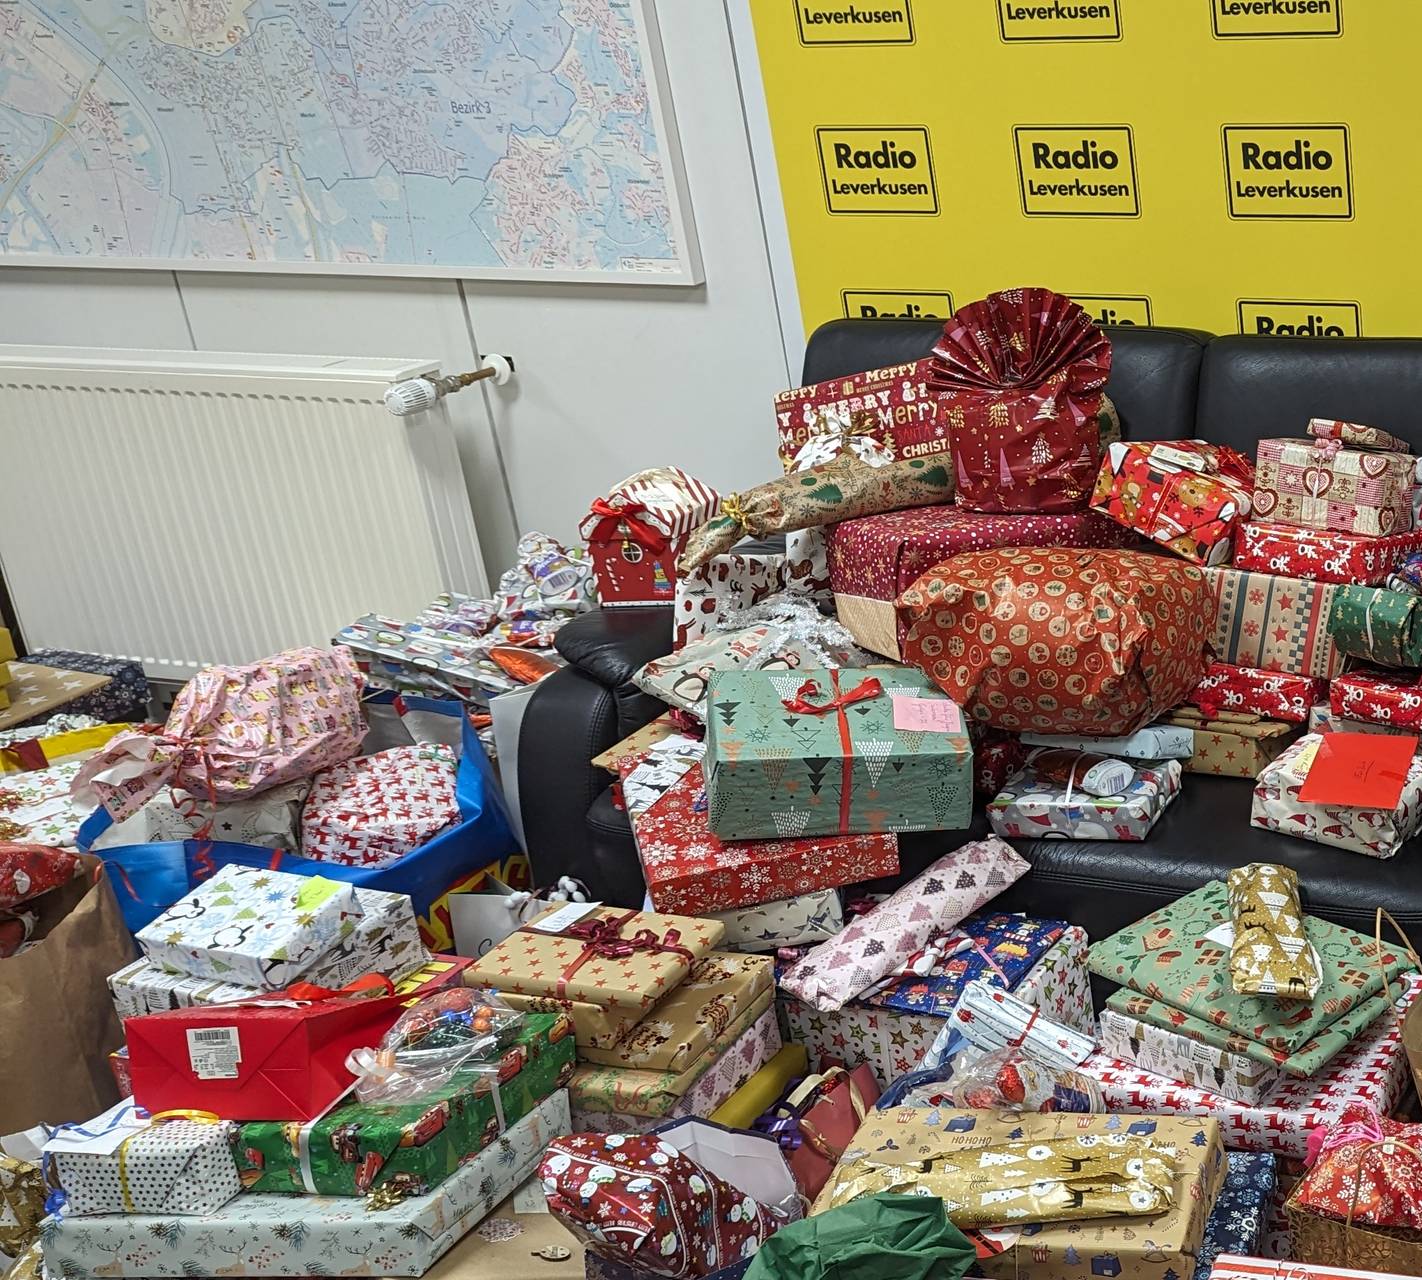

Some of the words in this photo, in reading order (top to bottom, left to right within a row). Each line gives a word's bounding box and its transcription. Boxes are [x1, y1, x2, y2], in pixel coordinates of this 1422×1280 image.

[804, 5, 904, 24] Leverkusen
[1006, 0, 1111, 20] Leverkusen
[1220, 0, 1331, 15] Leverkusen
[450, 100, 482, 114] Bezirk
[485, 101, 492, 113] 3
[833, 140, 917, 170] Radio
[1031, 139, 1119, 170] Radio
[1241, 139, 1333, 171] Radio
[831, 177, 929, 195] Leverkusen
[1028, 179, 1130, 197] Leverkusen
[1235, 179, 1343, 199] Leverkusen
[865, 362, 918, 384] Merry
[877, 400, 938, 431] Merry
